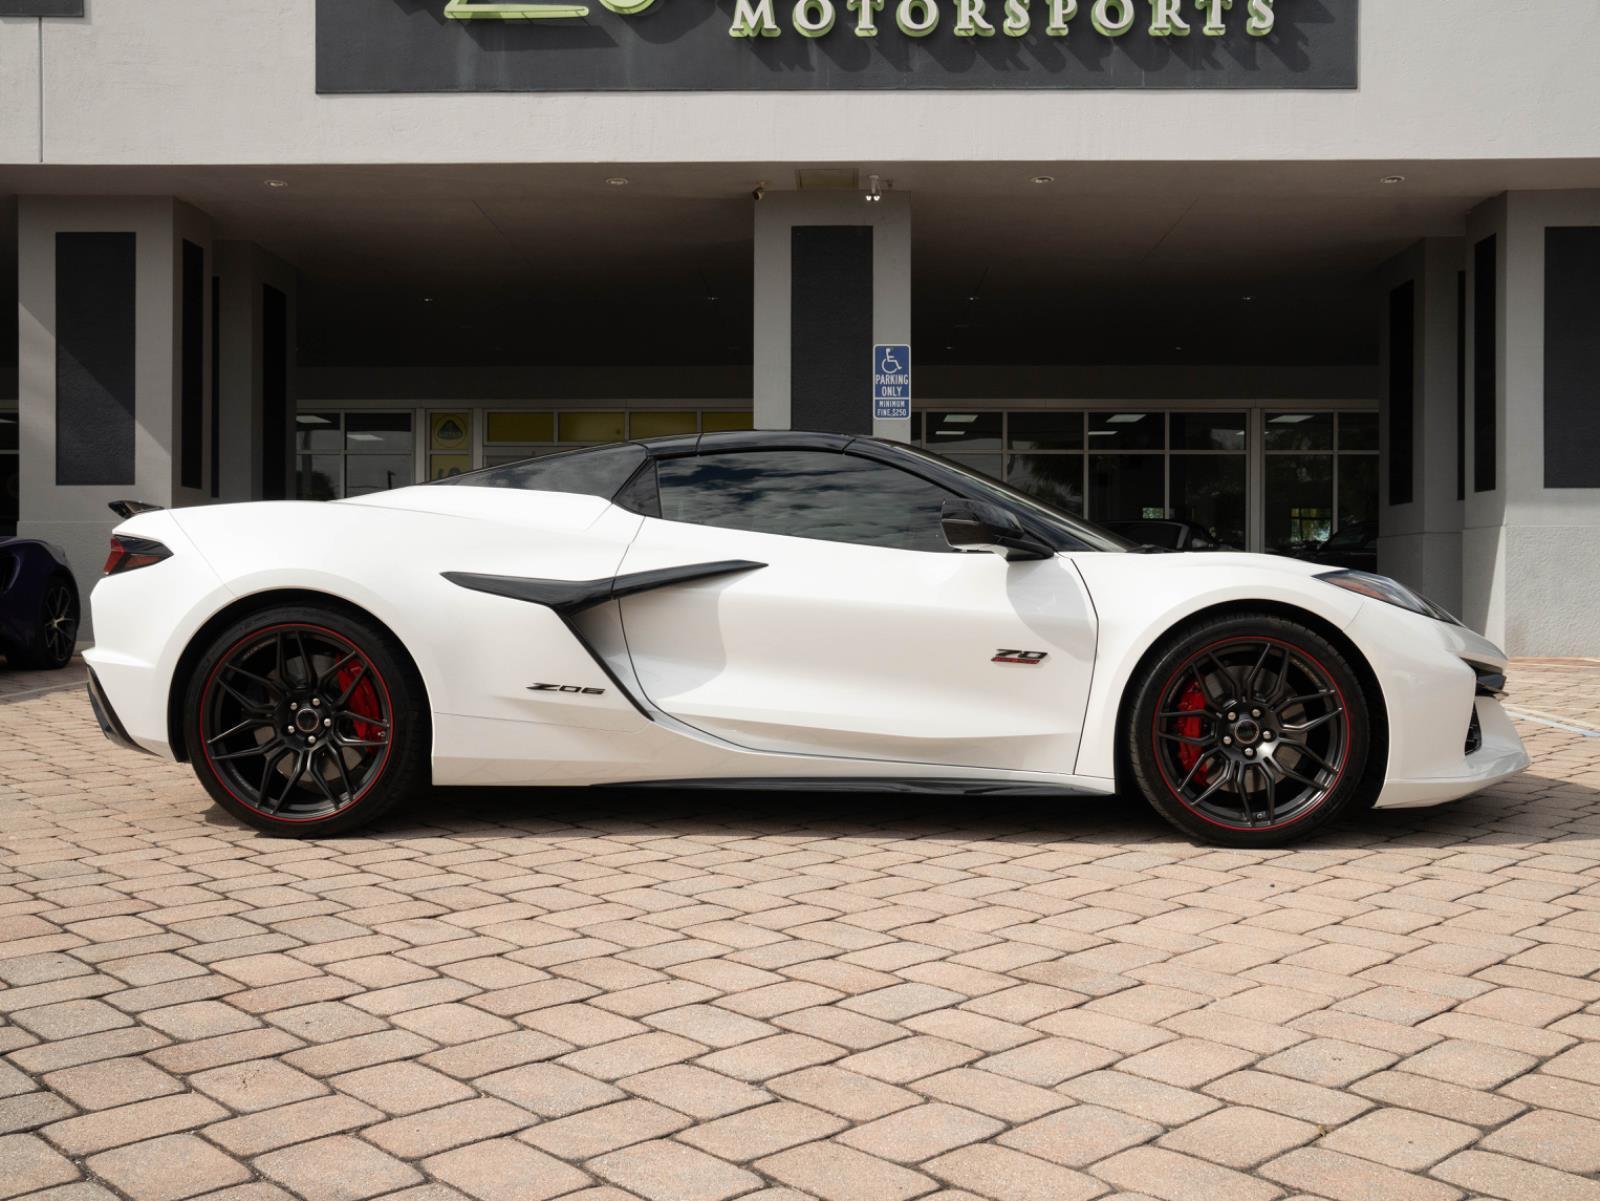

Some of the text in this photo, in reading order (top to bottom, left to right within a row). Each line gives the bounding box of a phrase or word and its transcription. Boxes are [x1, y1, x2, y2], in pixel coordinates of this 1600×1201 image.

[729, 0, 1275, 37] MOTORSPORTS
[875, 374, 909, 385] PARKING
[881, 386, 903, 397] ONLY
[879, 400, 905, 408] MINIMUM
[525, 682, 606, 695] Z06
